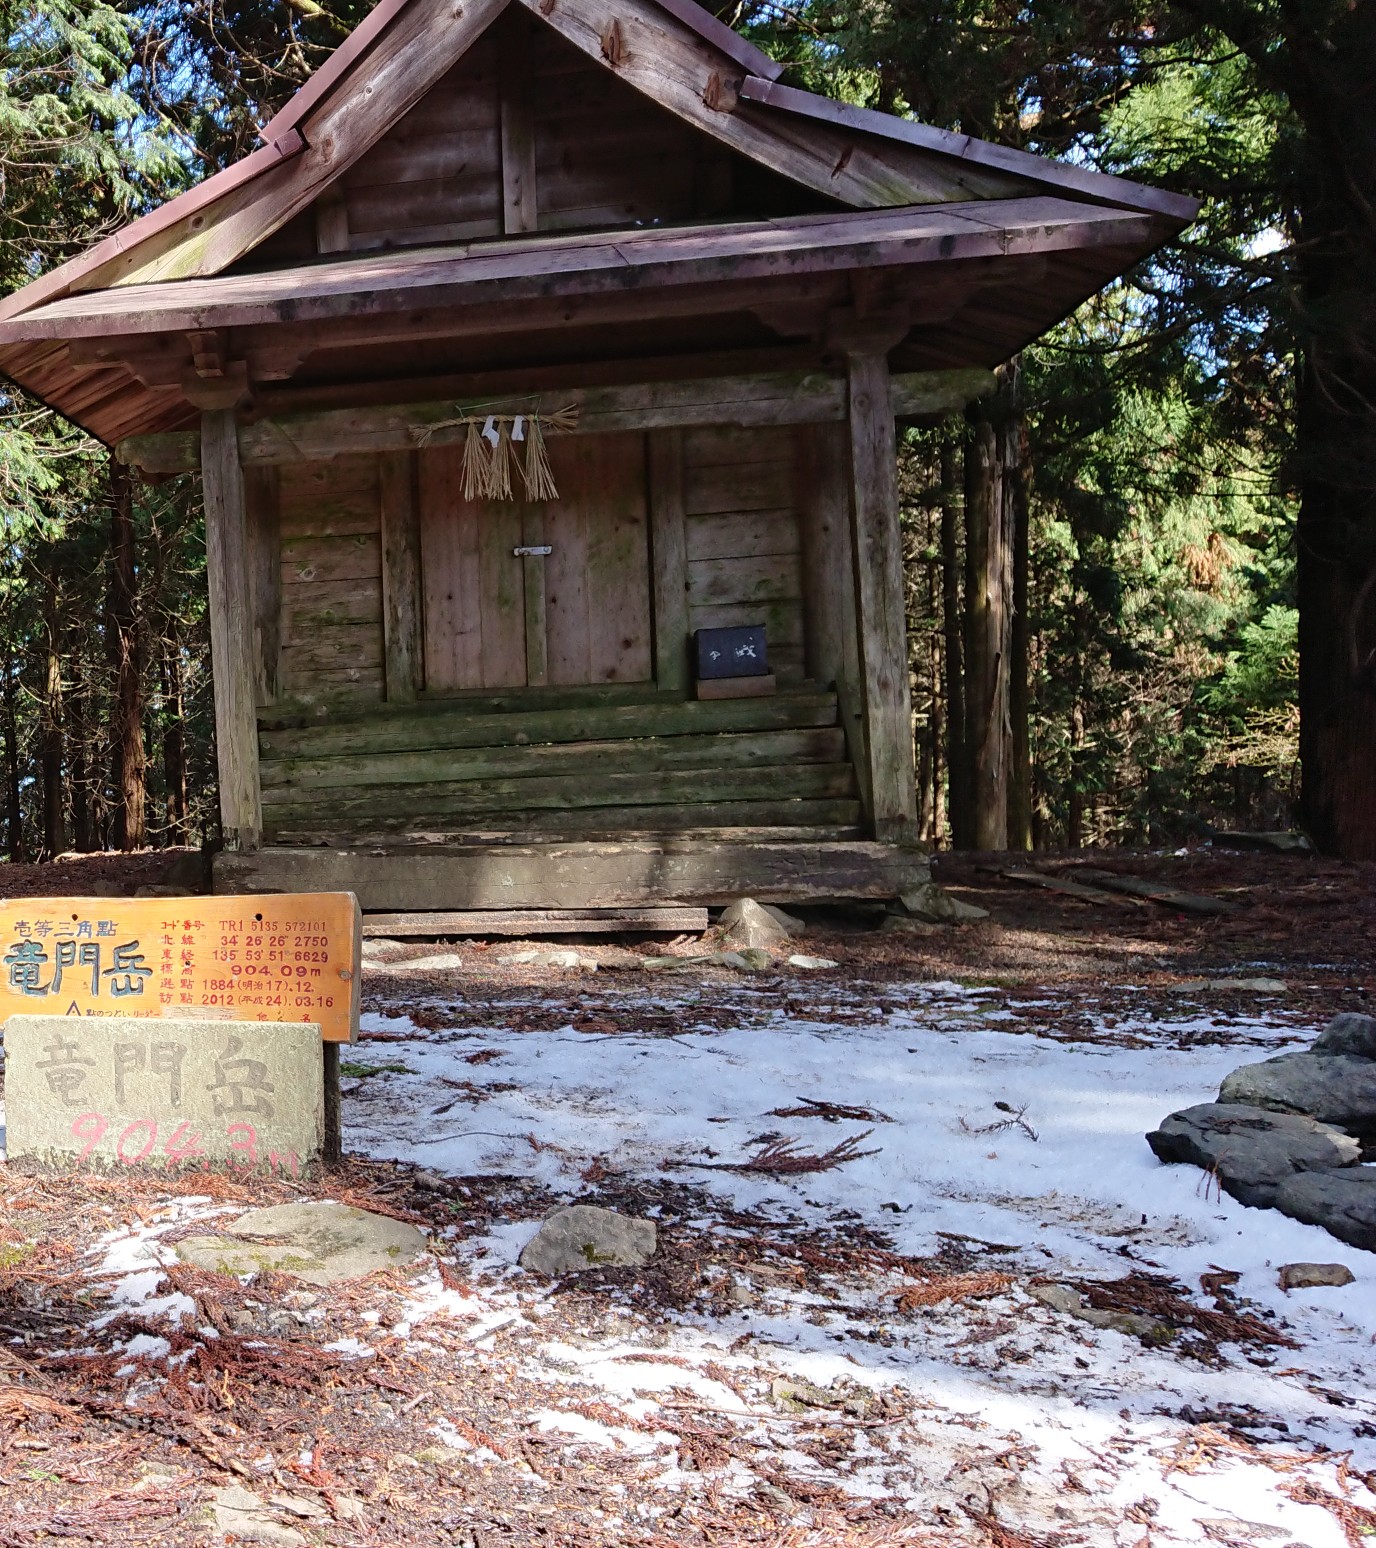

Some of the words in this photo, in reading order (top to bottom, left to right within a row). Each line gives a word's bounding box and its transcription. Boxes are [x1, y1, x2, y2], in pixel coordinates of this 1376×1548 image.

[219, 920, 243, 931] TR1
[251, 921, 279, 931] 5135
[285, 921, 326, 931] 572101
[294, 936, 328, 947] 2750
[161, 949, 195, 960] 東経
[294, 951, 328, 963] 6629
[3, 939, 153, 997] 竜門岳
[35, 1033, 275, 1119] 竜門岳
